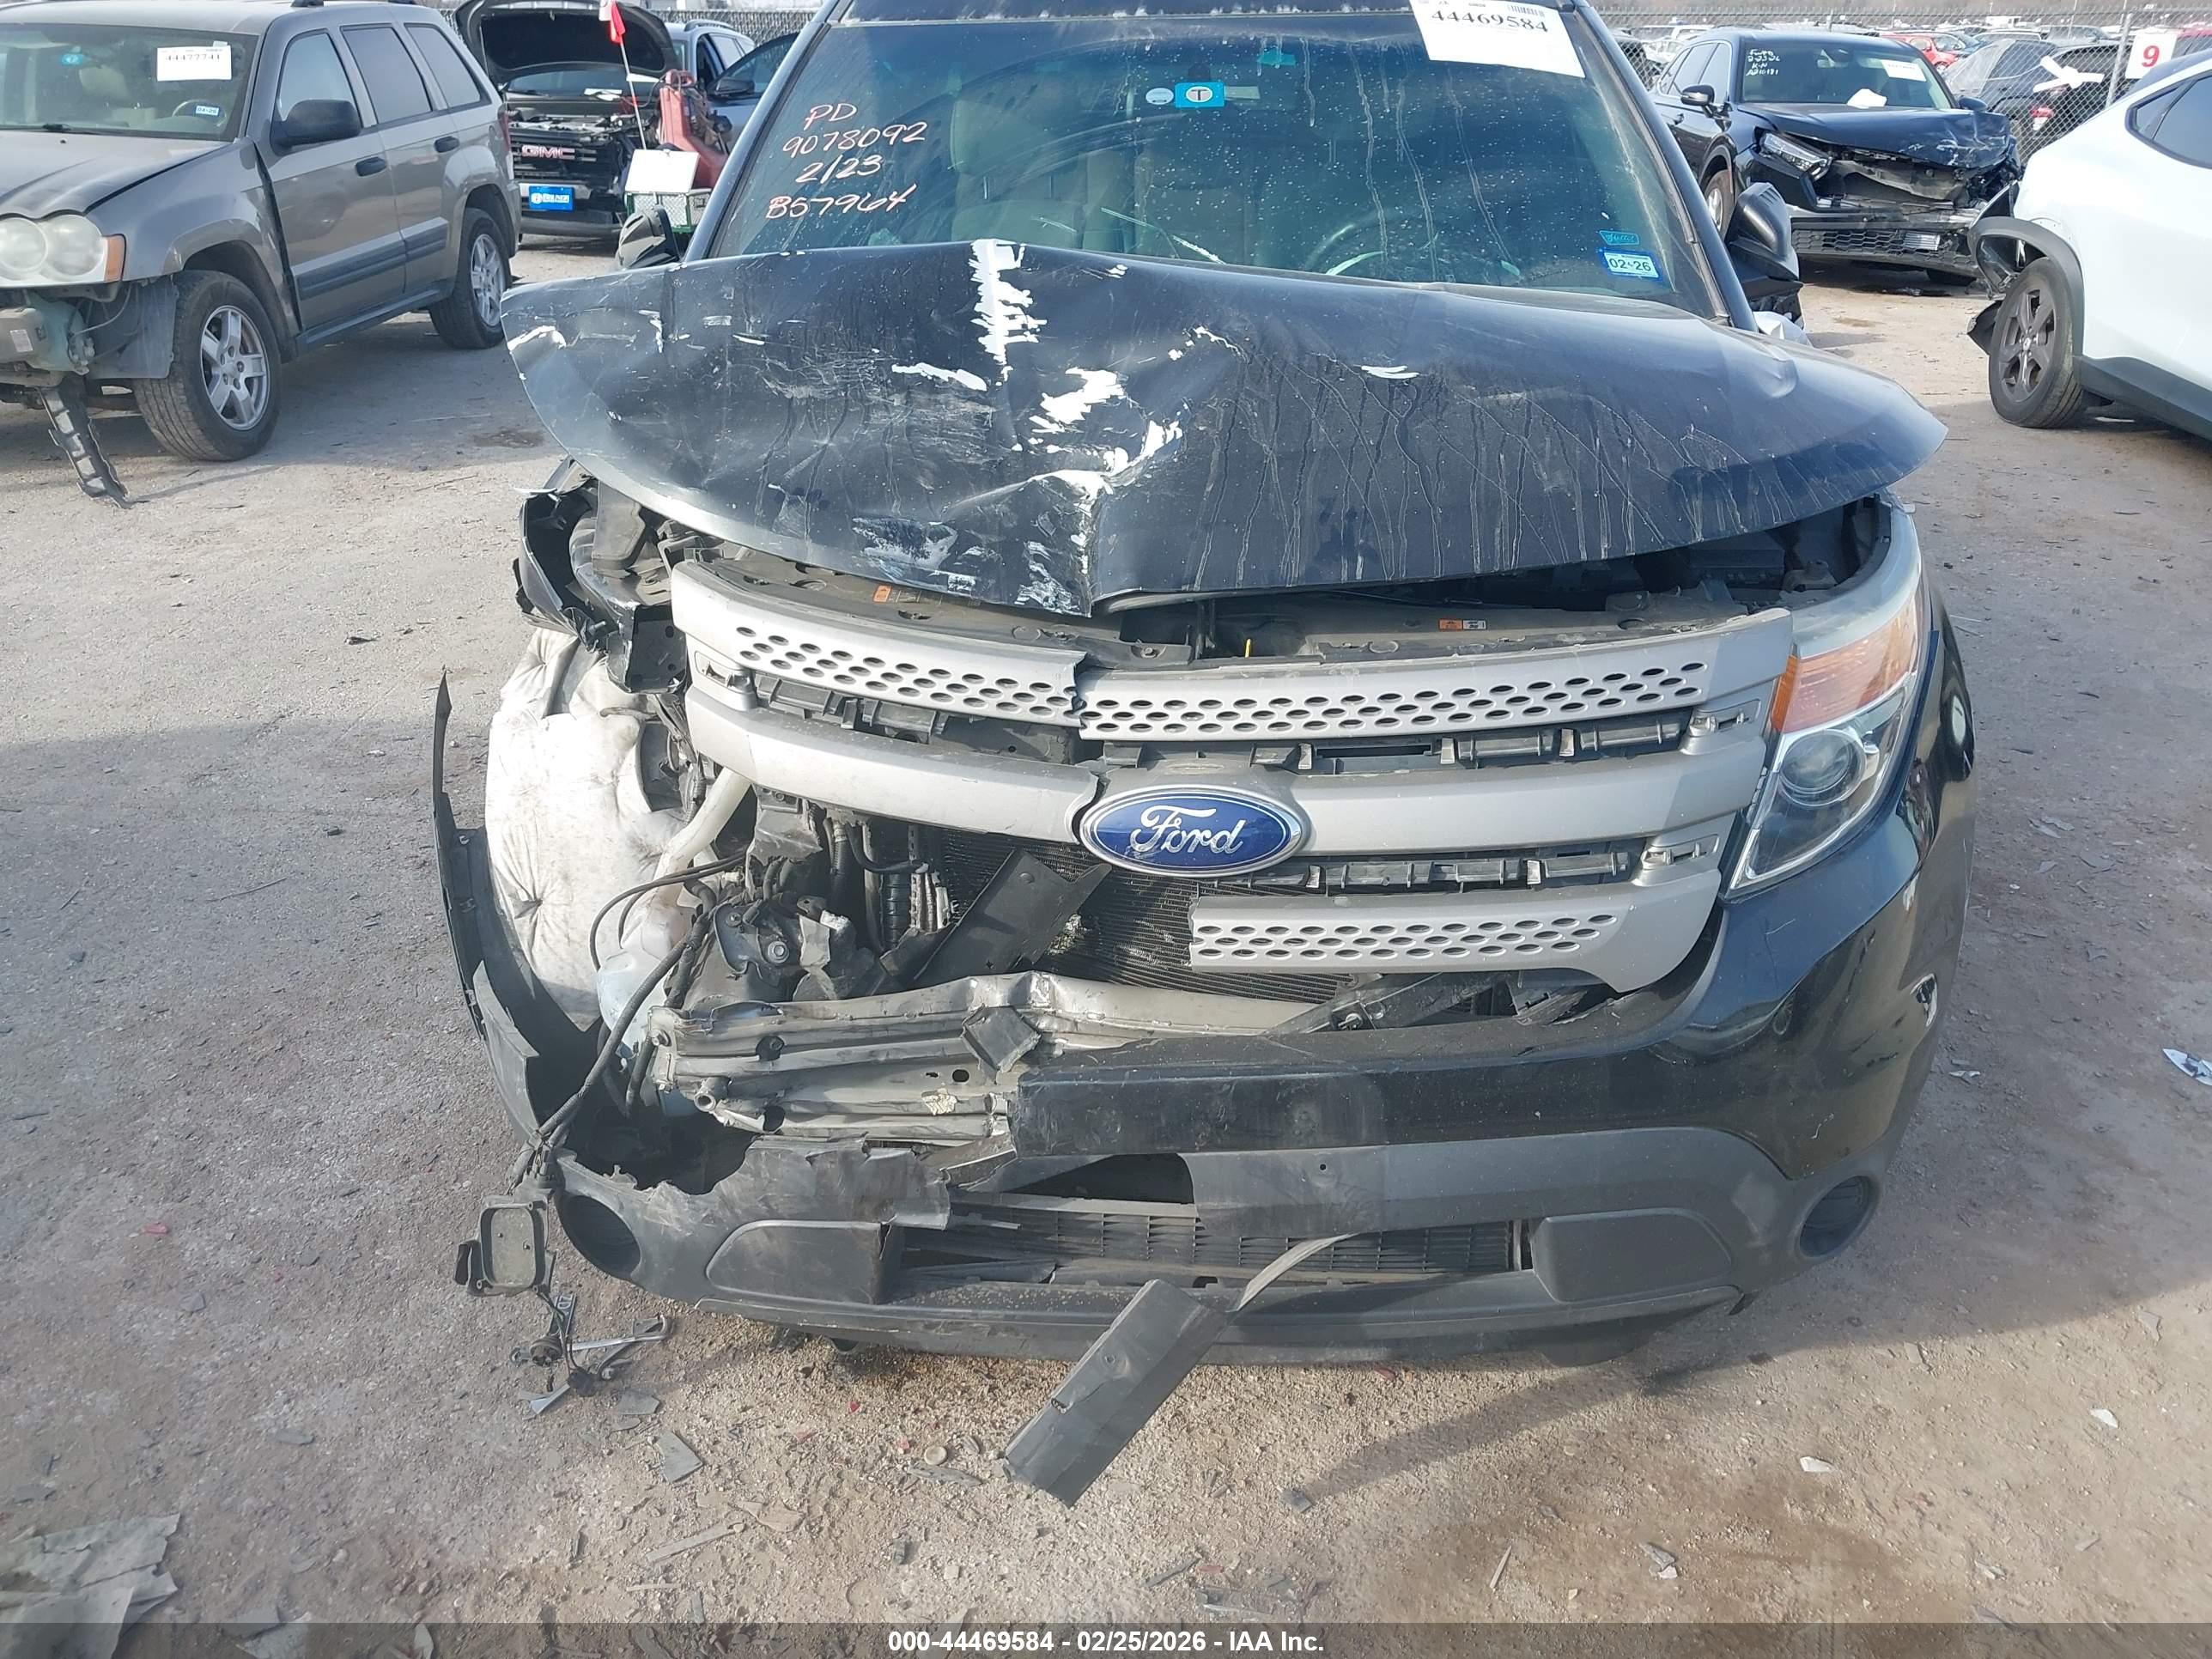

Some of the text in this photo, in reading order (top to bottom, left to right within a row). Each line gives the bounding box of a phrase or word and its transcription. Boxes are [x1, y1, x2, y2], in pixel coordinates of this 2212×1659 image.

[1431, 9, 1548, 33] 44469584
[2142, 45, 2160, 67] 9
[803, 103, 858, 131] PD
[521, 144, 575, 160] GMC
[782, 121, 928, 158] 9078092
[795, 154, 883, 184] 2/23
[765, 183, 918, 219] B57964
[1129, 805, 1246, 854] Ford
